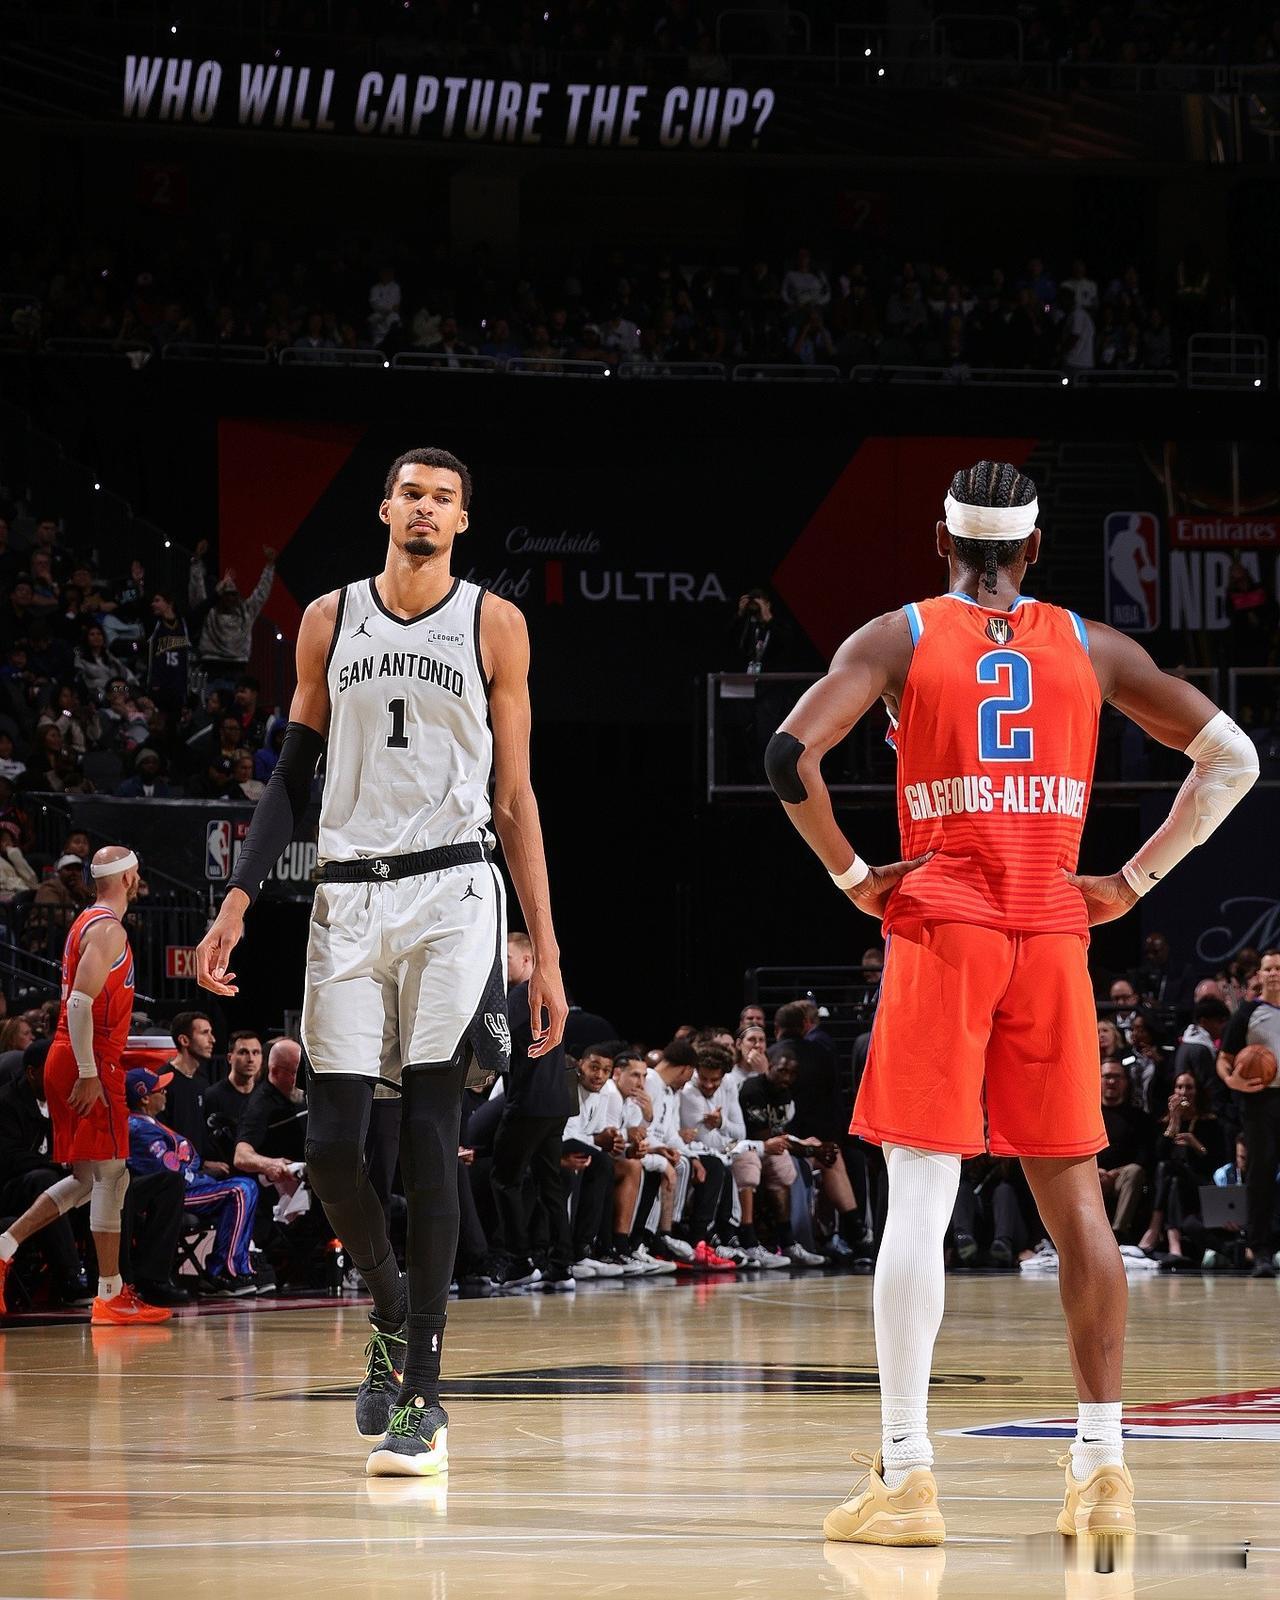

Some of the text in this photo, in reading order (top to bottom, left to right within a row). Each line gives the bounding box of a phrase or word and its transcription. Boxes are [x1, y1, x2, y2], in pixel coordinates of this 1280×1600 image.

[123, 55, 776, 149] WHO WILL CAPTURE THE CUP?
[1176, 518, 1277, 542] Emirates
[579, 570, 727, 602] ULTRA
[432, 633, 460, 642] LEDGER
[166, 651, 180, 667] 15
[338, 652, 464, 698] SAN ANTONIO
[386, 698, 409, 749] 1
[976, 648, 1034, 762] 2
[276, 840, 318, 881] CUP
